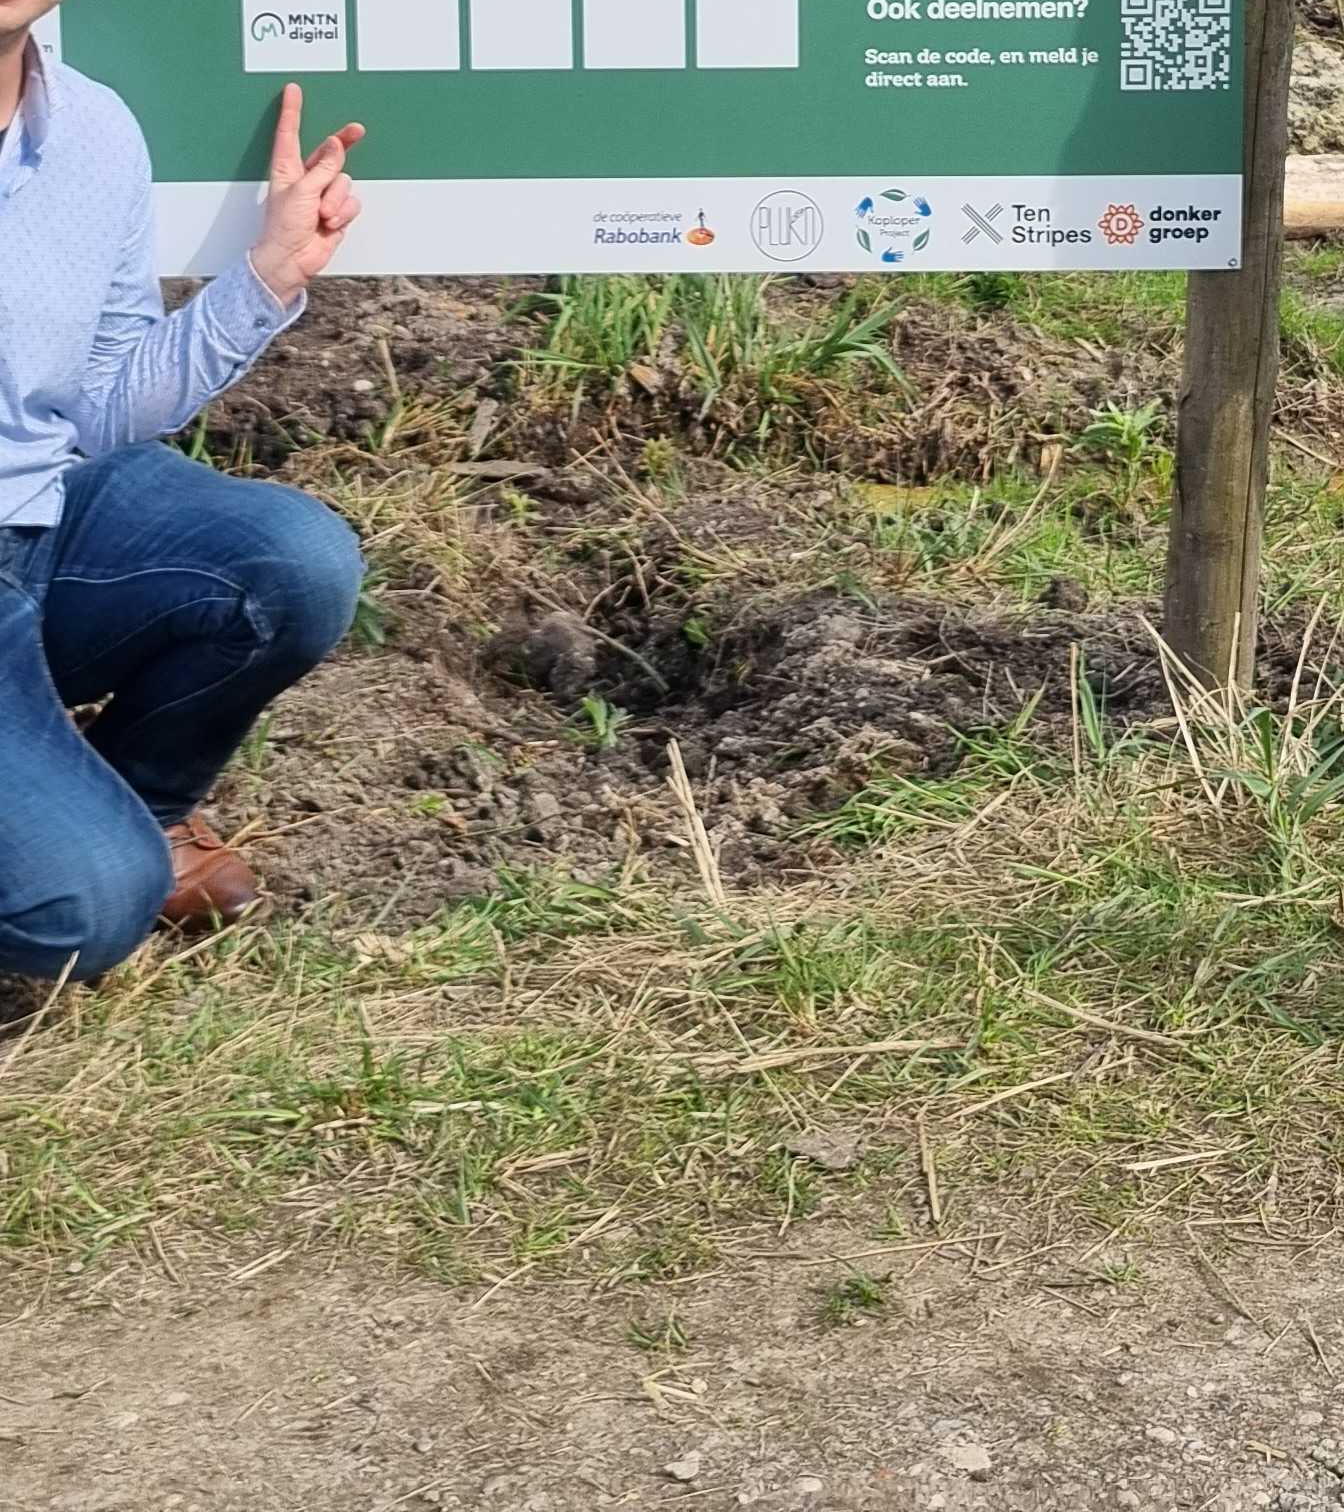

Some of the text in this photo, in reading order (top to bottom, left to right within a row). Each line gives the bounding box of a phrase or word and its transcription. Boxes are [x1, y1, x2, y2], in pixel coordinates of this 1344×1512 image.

[288, 14, 339, 25] MNTN
[288, 26, 339, 43] digital
[864, 48, 1100, 67] Scan de code, en meld je
[865, 71, 969, 88] direct aan.
[593, 211, 607, 222] de
[1011, 204, 1051, 222] Ten
[1150, 206, 1221, 222] donker
[594, 227, 682, 244] Rabobank
[1011, 225, 1092, 248] Stripes
[1150, 226, 1209, 244] groep
